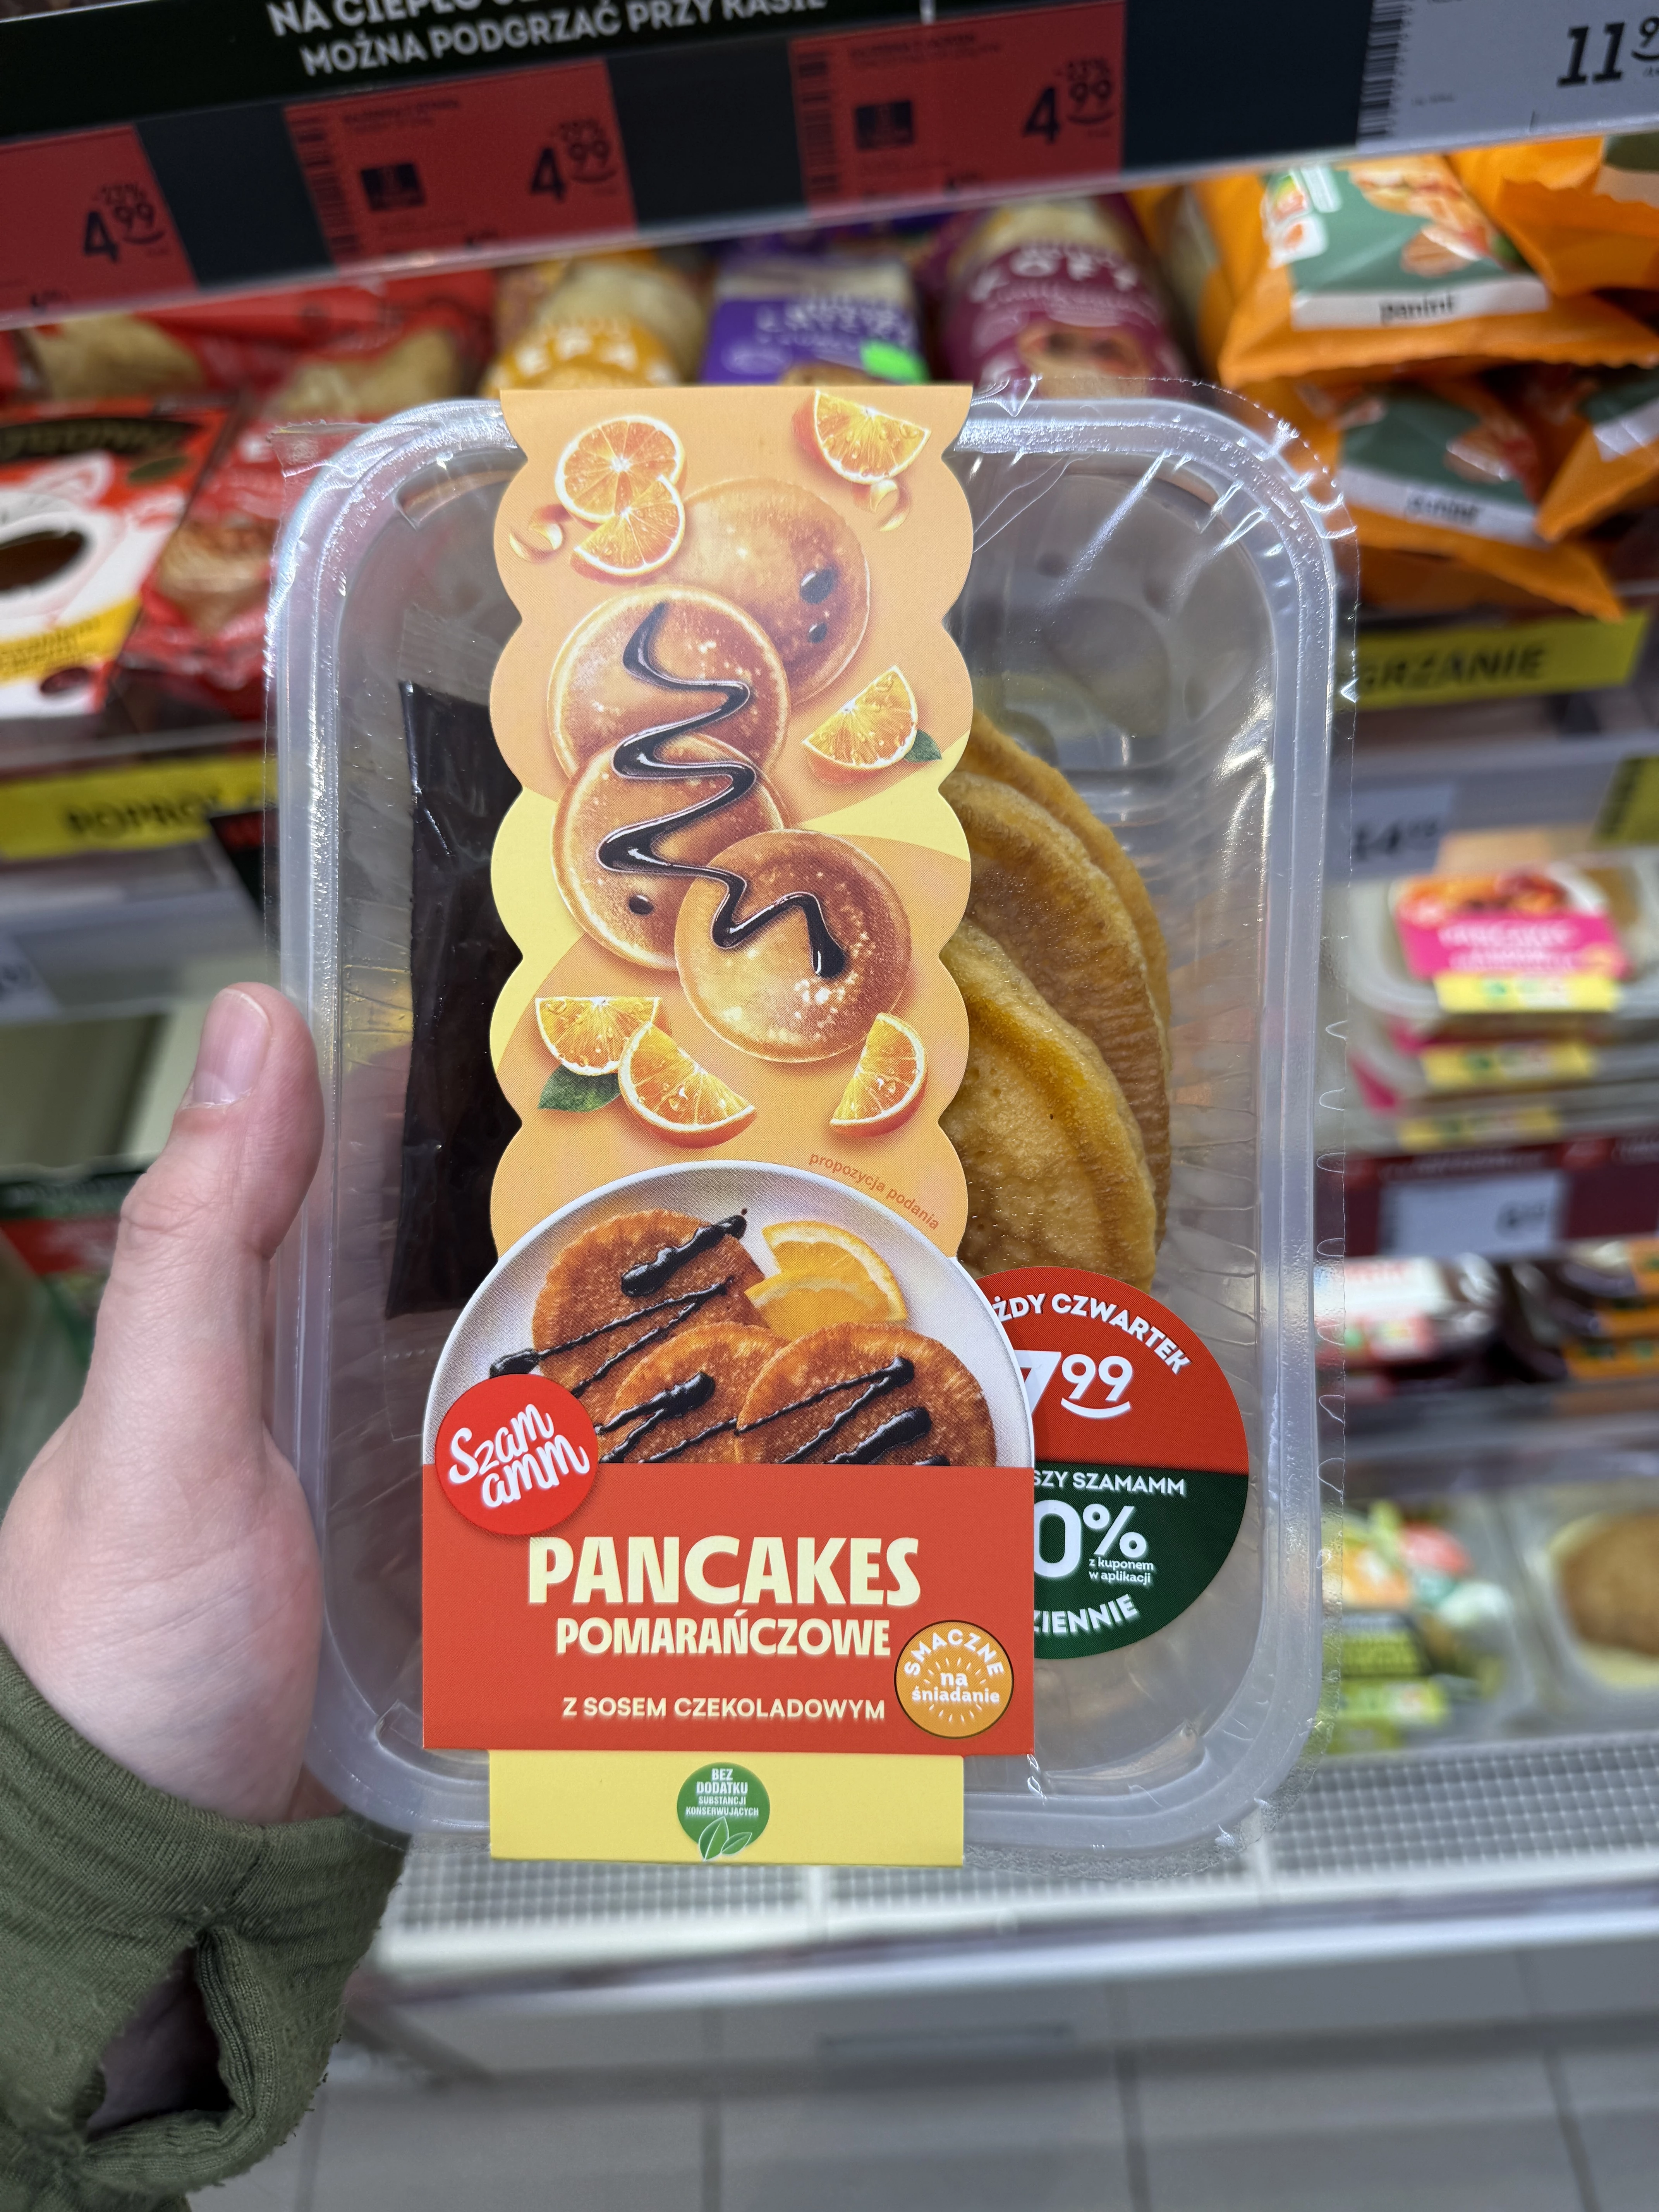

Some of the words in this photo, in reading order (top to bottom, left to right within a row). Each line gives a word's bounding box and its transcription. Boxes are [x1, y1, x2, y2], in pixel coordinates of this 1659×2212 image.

[266, 0, 333, 36] NA
[332, 0, 483, 26] CIEP
[299, 29, 428, 76] MOŻNA
[428, 0, 622, 59] PODGRZAĆ
[625, 0, 712, 32] PRZY
[809, 1154, 885, 1192] propozycja
[886, 1188, 939, 1230] podania
[1051, 1293, 1192, 1375] CZWARTEK
[449, 1404, 554, 1484] Szam
[483, 1435, 590, 1507] amm
[1072, 1472, 1185, 1495] SZAMAMM
[529, 1535, 921, 1606] PANCAKES
[1098, 1556, 1154, 1570] kuponem
[1089, 1571, 1099, 1579] w
[1101, 1570, 1151, 1585] aplikacji
[557, 1609, 891, 1656] POMARAŃCZOWE
[904, 1628, 1005, 1677] SMACZNE
[940, 1672, 968, 1687] na
[912, 1685, 1000, 1703] śniadanie
[563, 1697, 577, 1716] Z
[584, 1697, 666, 1717] SOSEM
[674, 1697, 885, 1719] CZEKOLADOWYM
[711, 1768, 733, 1781] BEZ
[696, 1781, 748, 1794] DODATKU
[685, 1806, 759, 1816] KONSERWUJĄCYCH
[698, 1796, 746, 1805] SUBSTANCJI
